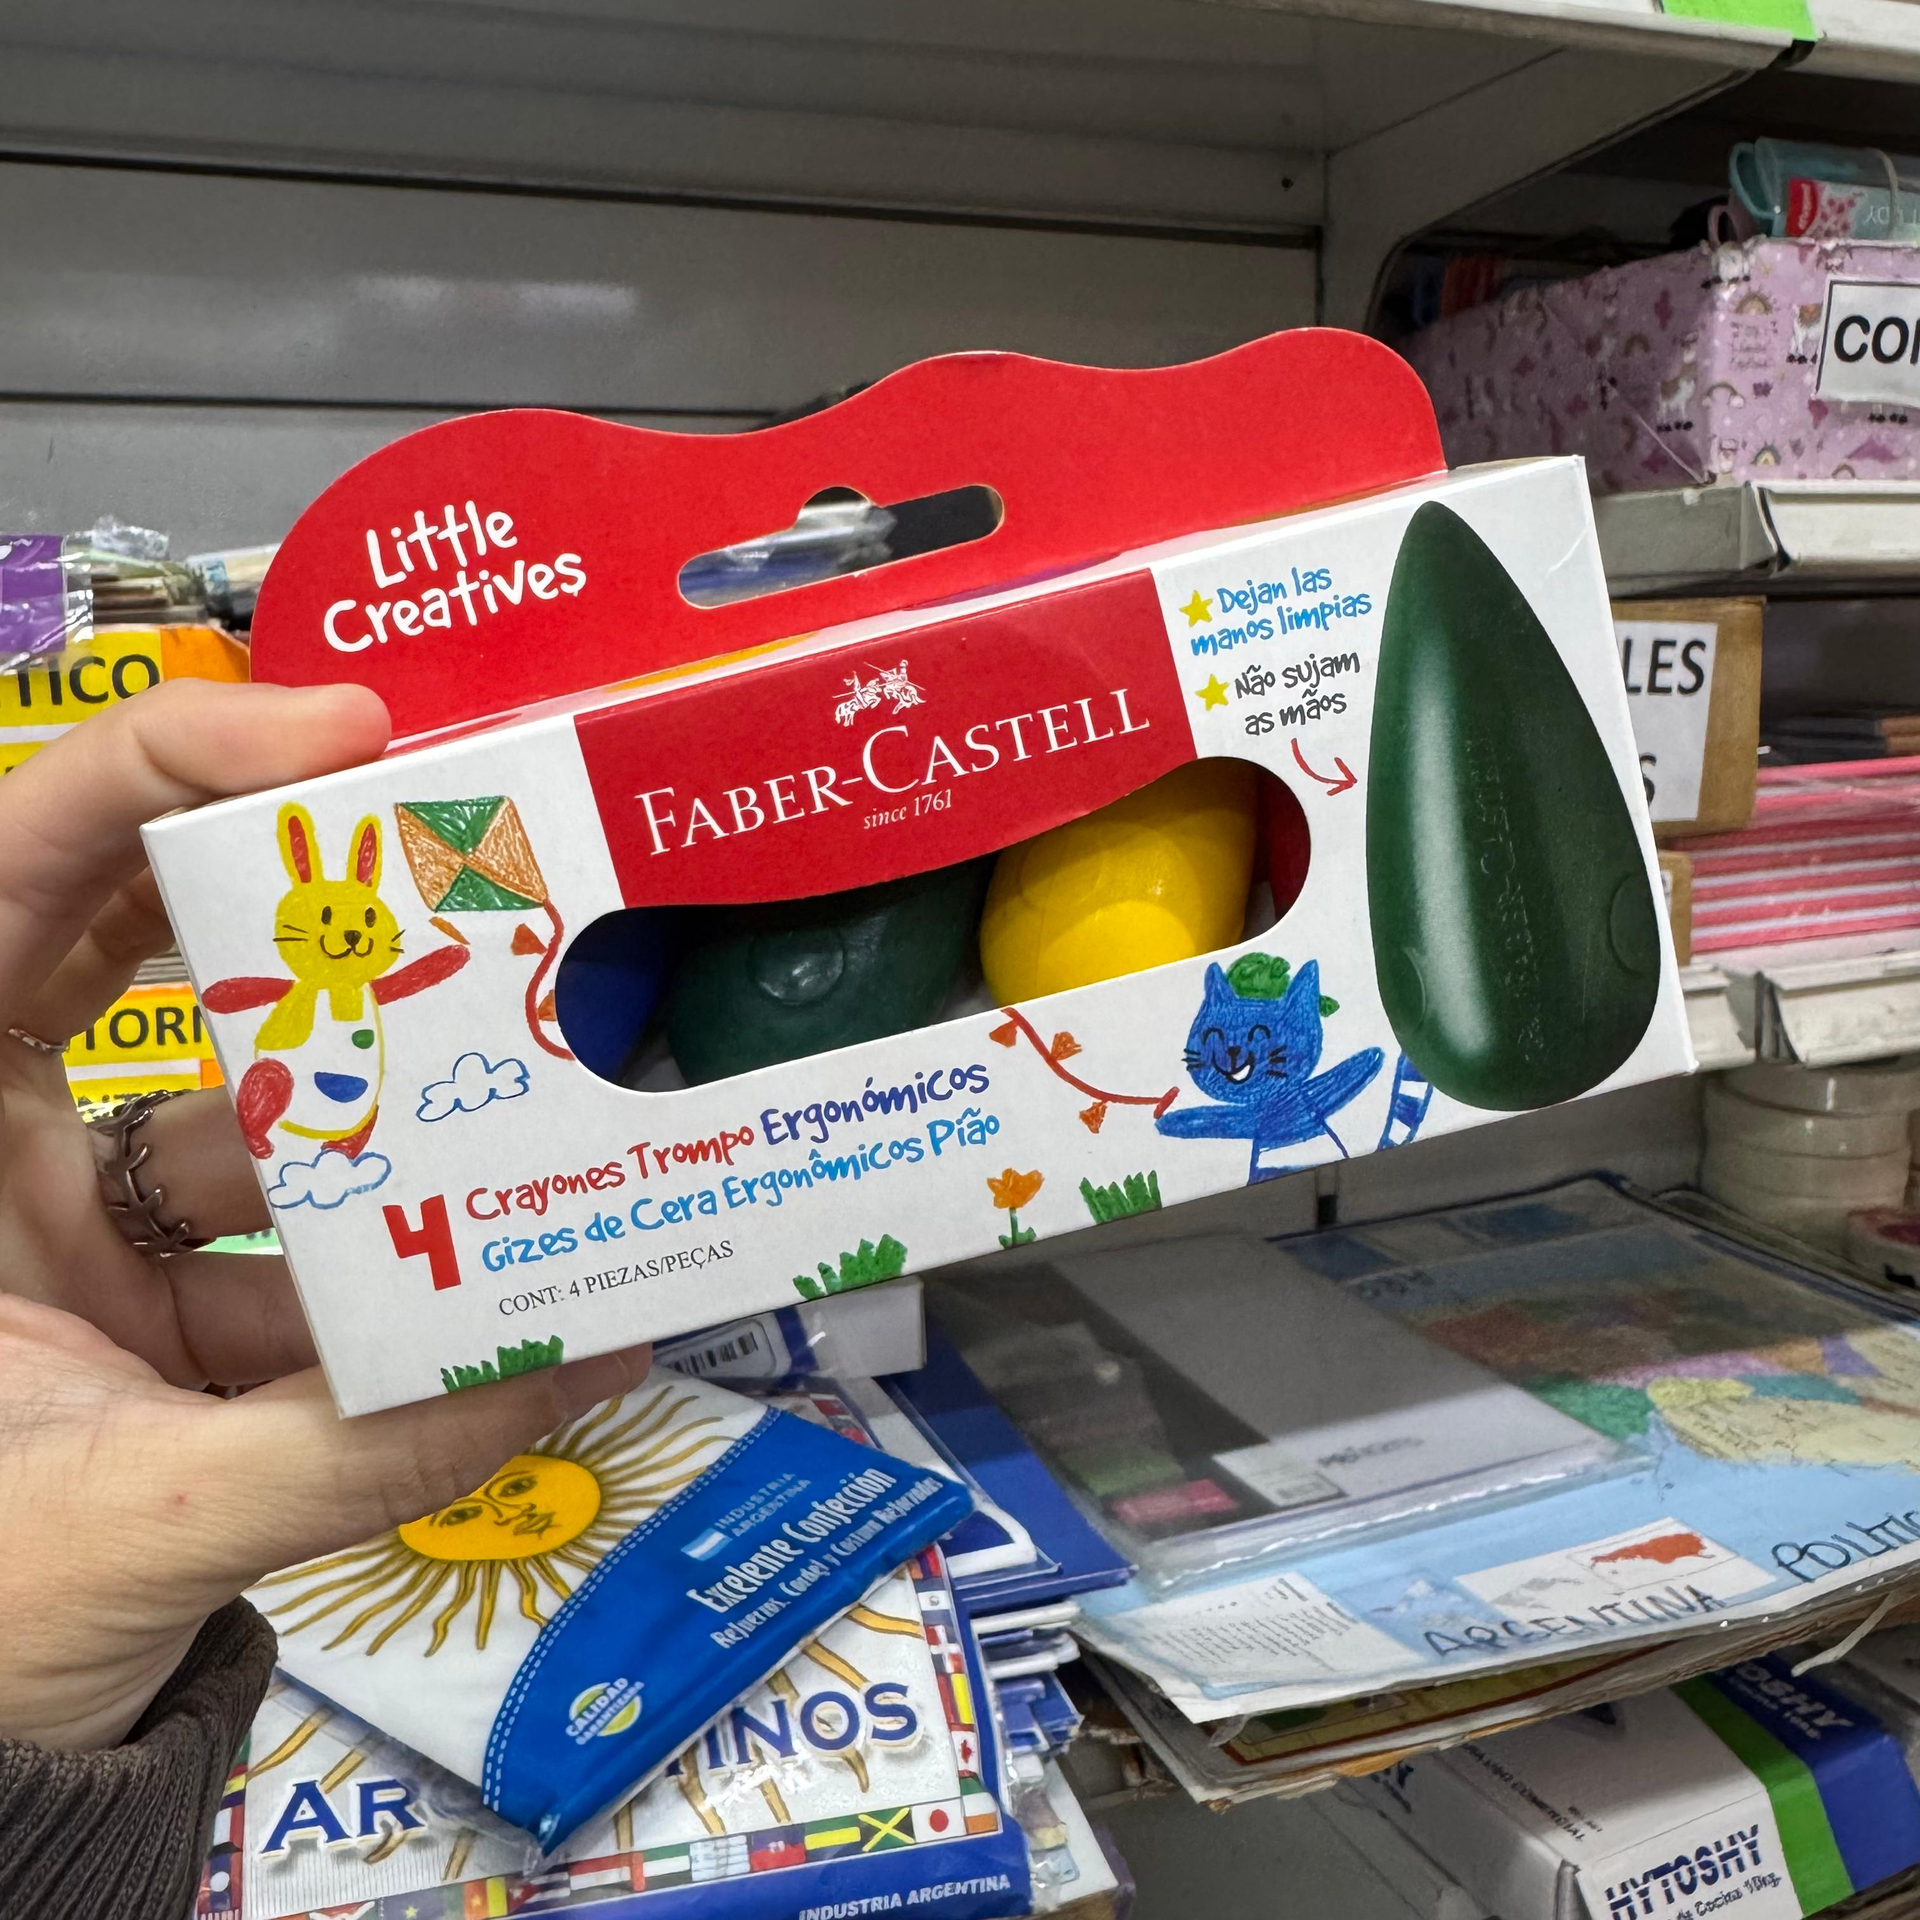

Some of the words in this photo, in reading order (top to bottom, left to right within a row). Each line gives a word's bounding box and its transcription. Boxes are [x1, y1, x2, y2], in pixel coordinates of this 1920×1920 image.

[366, 500, 518, 589] Little
[323, 553, 587, 653] Creatives
[1190, 618, 1274, 656] manos
[1277, 593, 1372, 635] limpias
[1216, 580, 1288, 616] Dejan
[1291, 567, 1333, 596] las
[1234, 664, 1276, 699] Não
[1281, 653, 1360, 689] sujam
[1244, 711, 1275, 736] as
[1278, 688, 1347, 726] mãos
[634, 688, 1151, 857] FABER-CASTELL
[863, 804, 907, 830] since
[914, 789, 953, 818] 1761
[465, 1161, 626, 1220] Crayones
[627, 1126, 755, 1179] Trompo
[760, 1064, 989, 1145] Ergonómicos
[482, 1227, 578, 1272] Gizes
[584, 1212, 626, 1242] de
[630, 1190, 718, 1230] Cera
[721, 1137, 925, 1207] Ergonômicos
[926, 1107, 1001, 1156] Pião
[382, 1194, 462, 1291] 4
[498, 1286, 566, 1316] CONT:
[569, 1279, 581, 1298] 4
[584, 1239, 734, 1294] PIEZAS/PEÇAS
[686, 1538, 805, 1614] Excelente
[781, 1467, 897, 1543] Confección
[565, 1677, 629, 1737] CALIDAD
[798, 1892, 902, 1920] INDUSTRIA
[906, 1874, 1011, 1905] ARGENTINA
[1604, 1823, 1763, 1920] HYTOSHY
